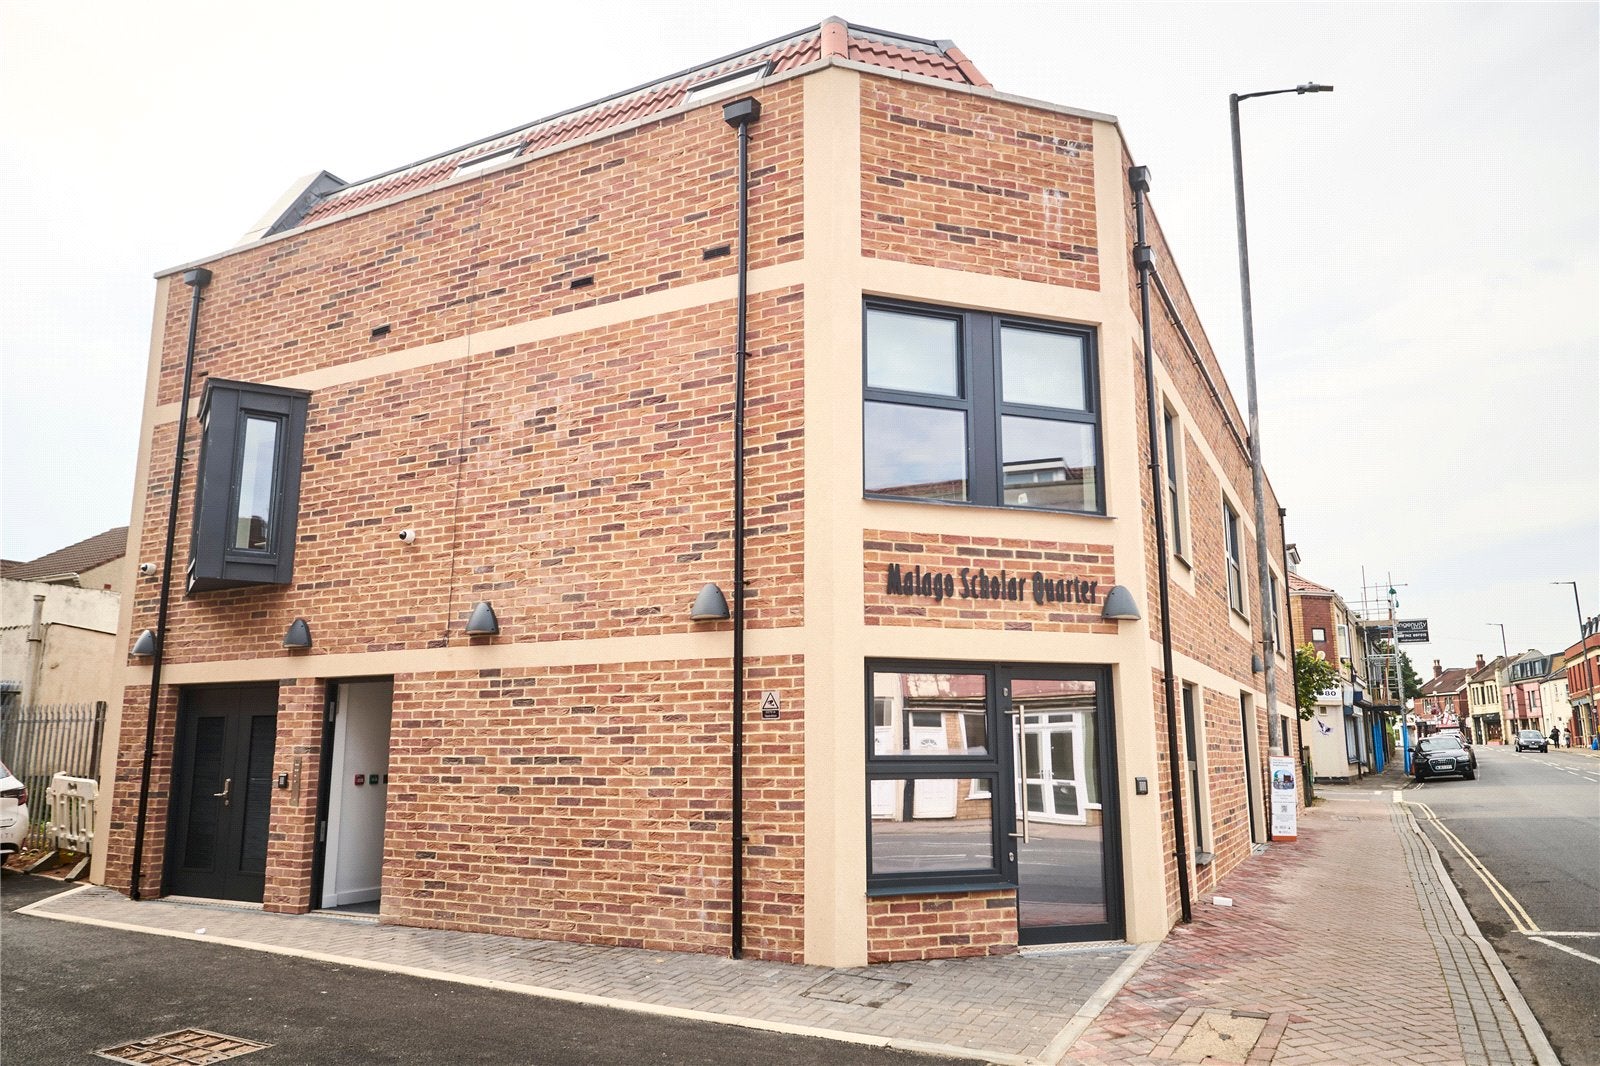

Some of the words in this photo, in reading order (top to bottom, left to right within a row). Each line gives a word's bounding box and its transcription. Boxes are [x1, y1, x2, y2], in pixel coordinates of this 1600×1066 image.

[886, 563, 954, 602] Malago
[960, 567, 1026, 601] Scholar
[1032, 571, 1098, 605] Quarter
[1397, 621, 1427, 629] ngenuity
